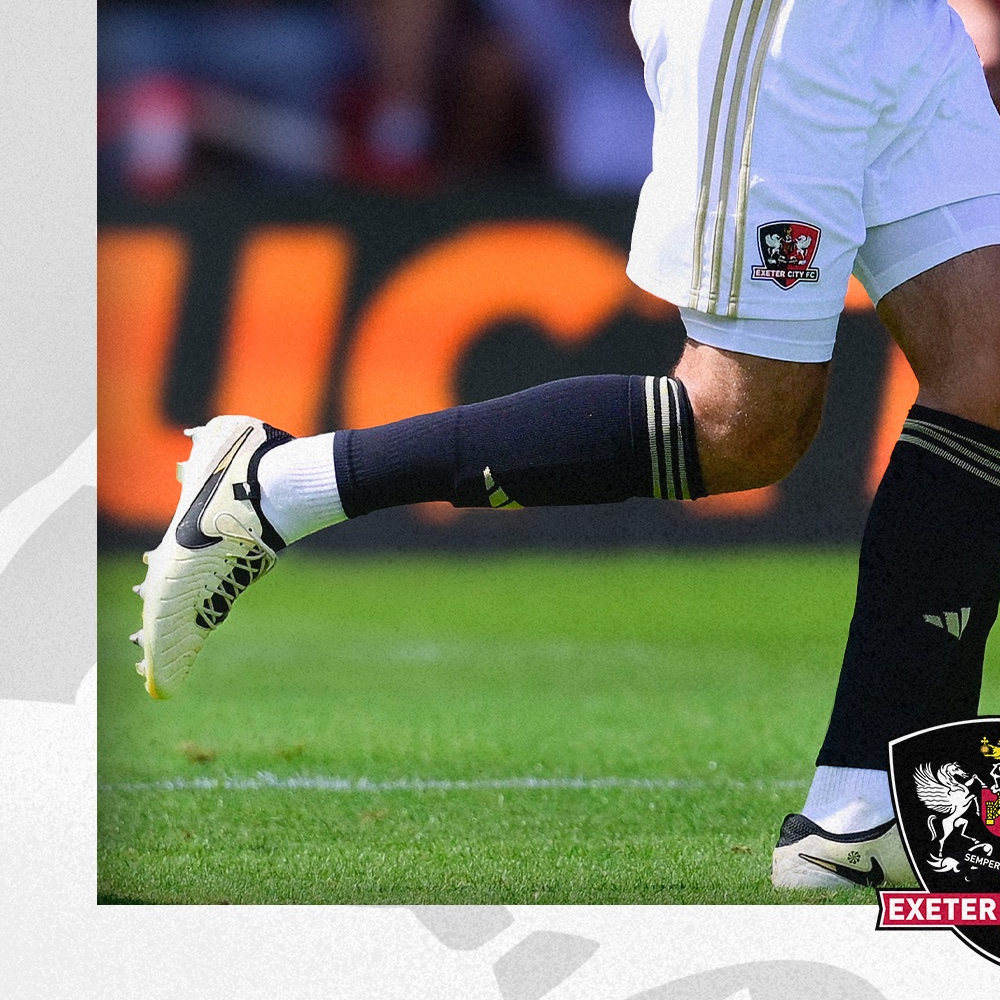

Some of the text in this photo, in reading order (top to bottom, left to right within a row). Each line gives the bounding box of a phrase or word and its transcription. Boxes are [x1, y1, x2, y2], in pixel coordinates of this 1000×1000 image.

[755, 269, 816, 279] EXETER CITY FC
